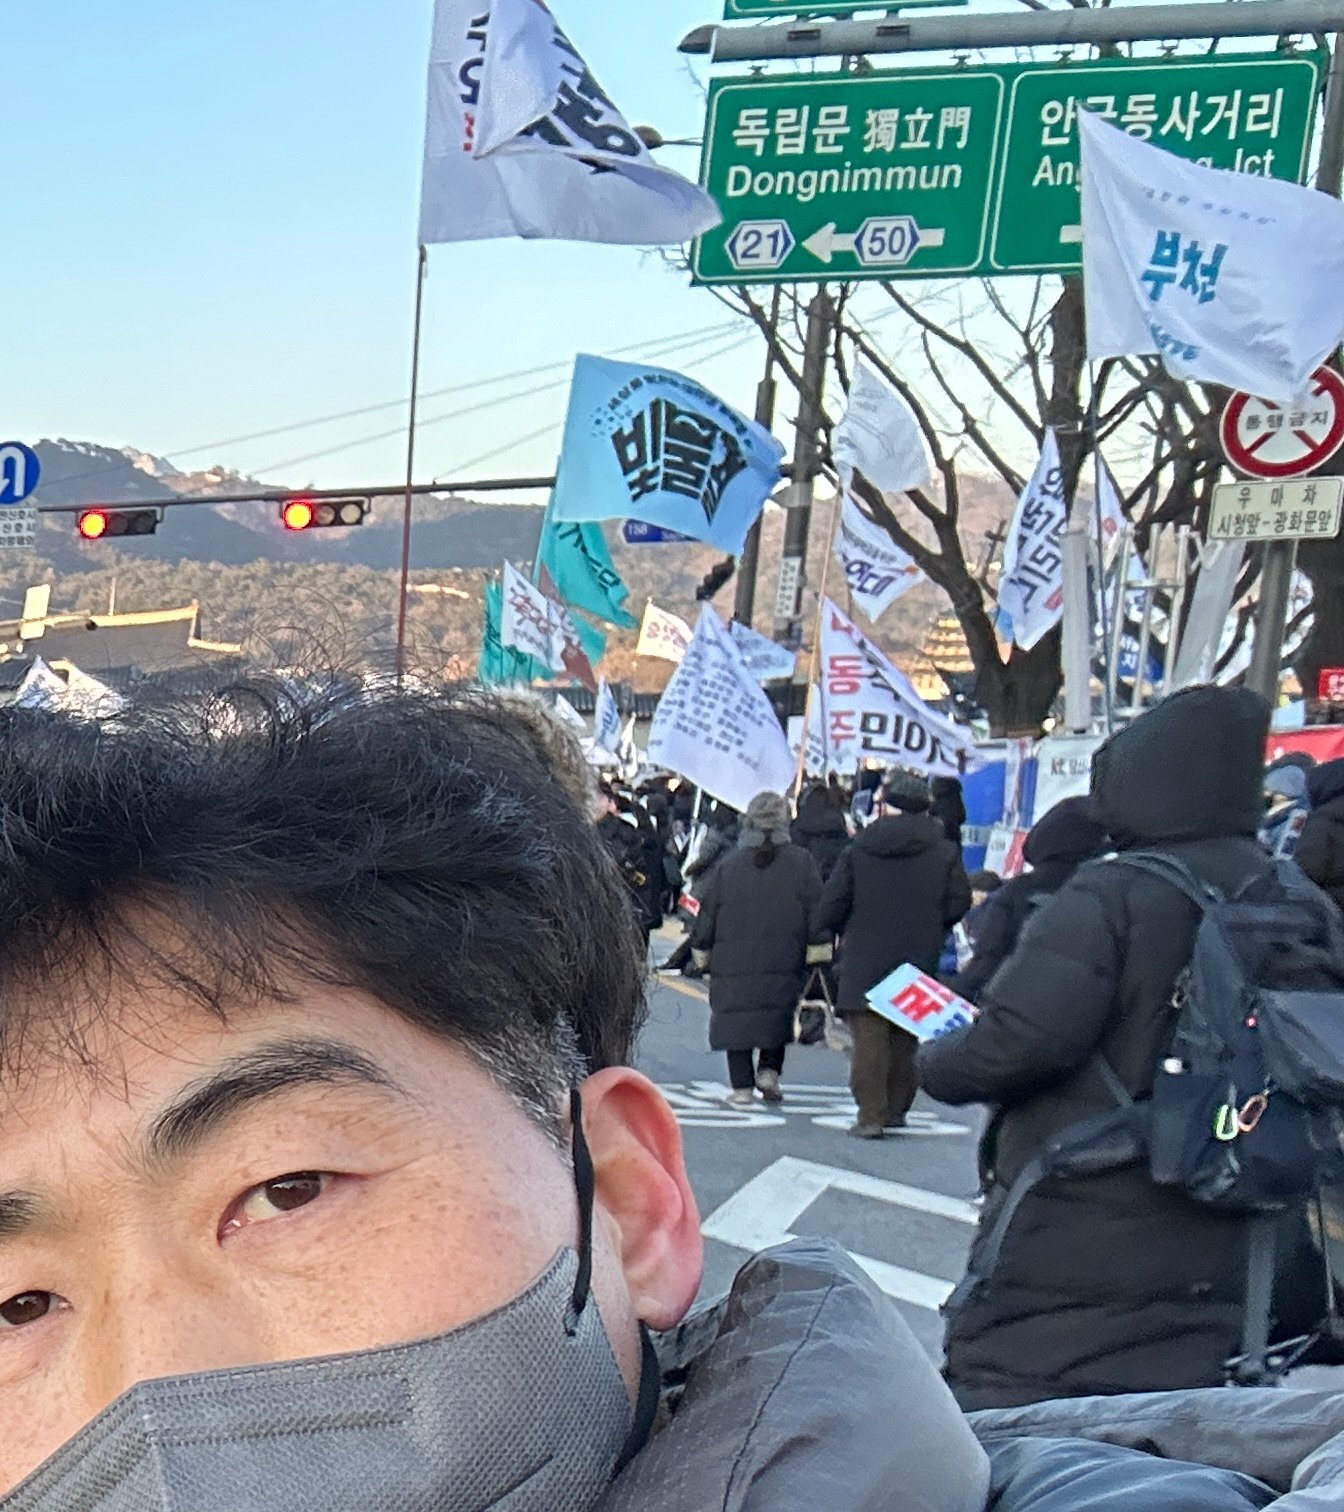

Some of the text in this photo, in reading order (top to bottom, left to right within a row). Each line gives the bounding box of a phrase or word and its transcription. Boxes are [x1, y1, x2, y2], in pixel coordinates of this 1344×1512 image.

[732, 105, 972, 156] 독립문 獨立門
[726, 161, 963, 202] Dongnimmun
[741, 229, 783, 259] 21
[868, 226, 906, 256] 50
[1141, 229, 1229, 305] 부천
[1246, 410, 1329, 431] 통행금지
